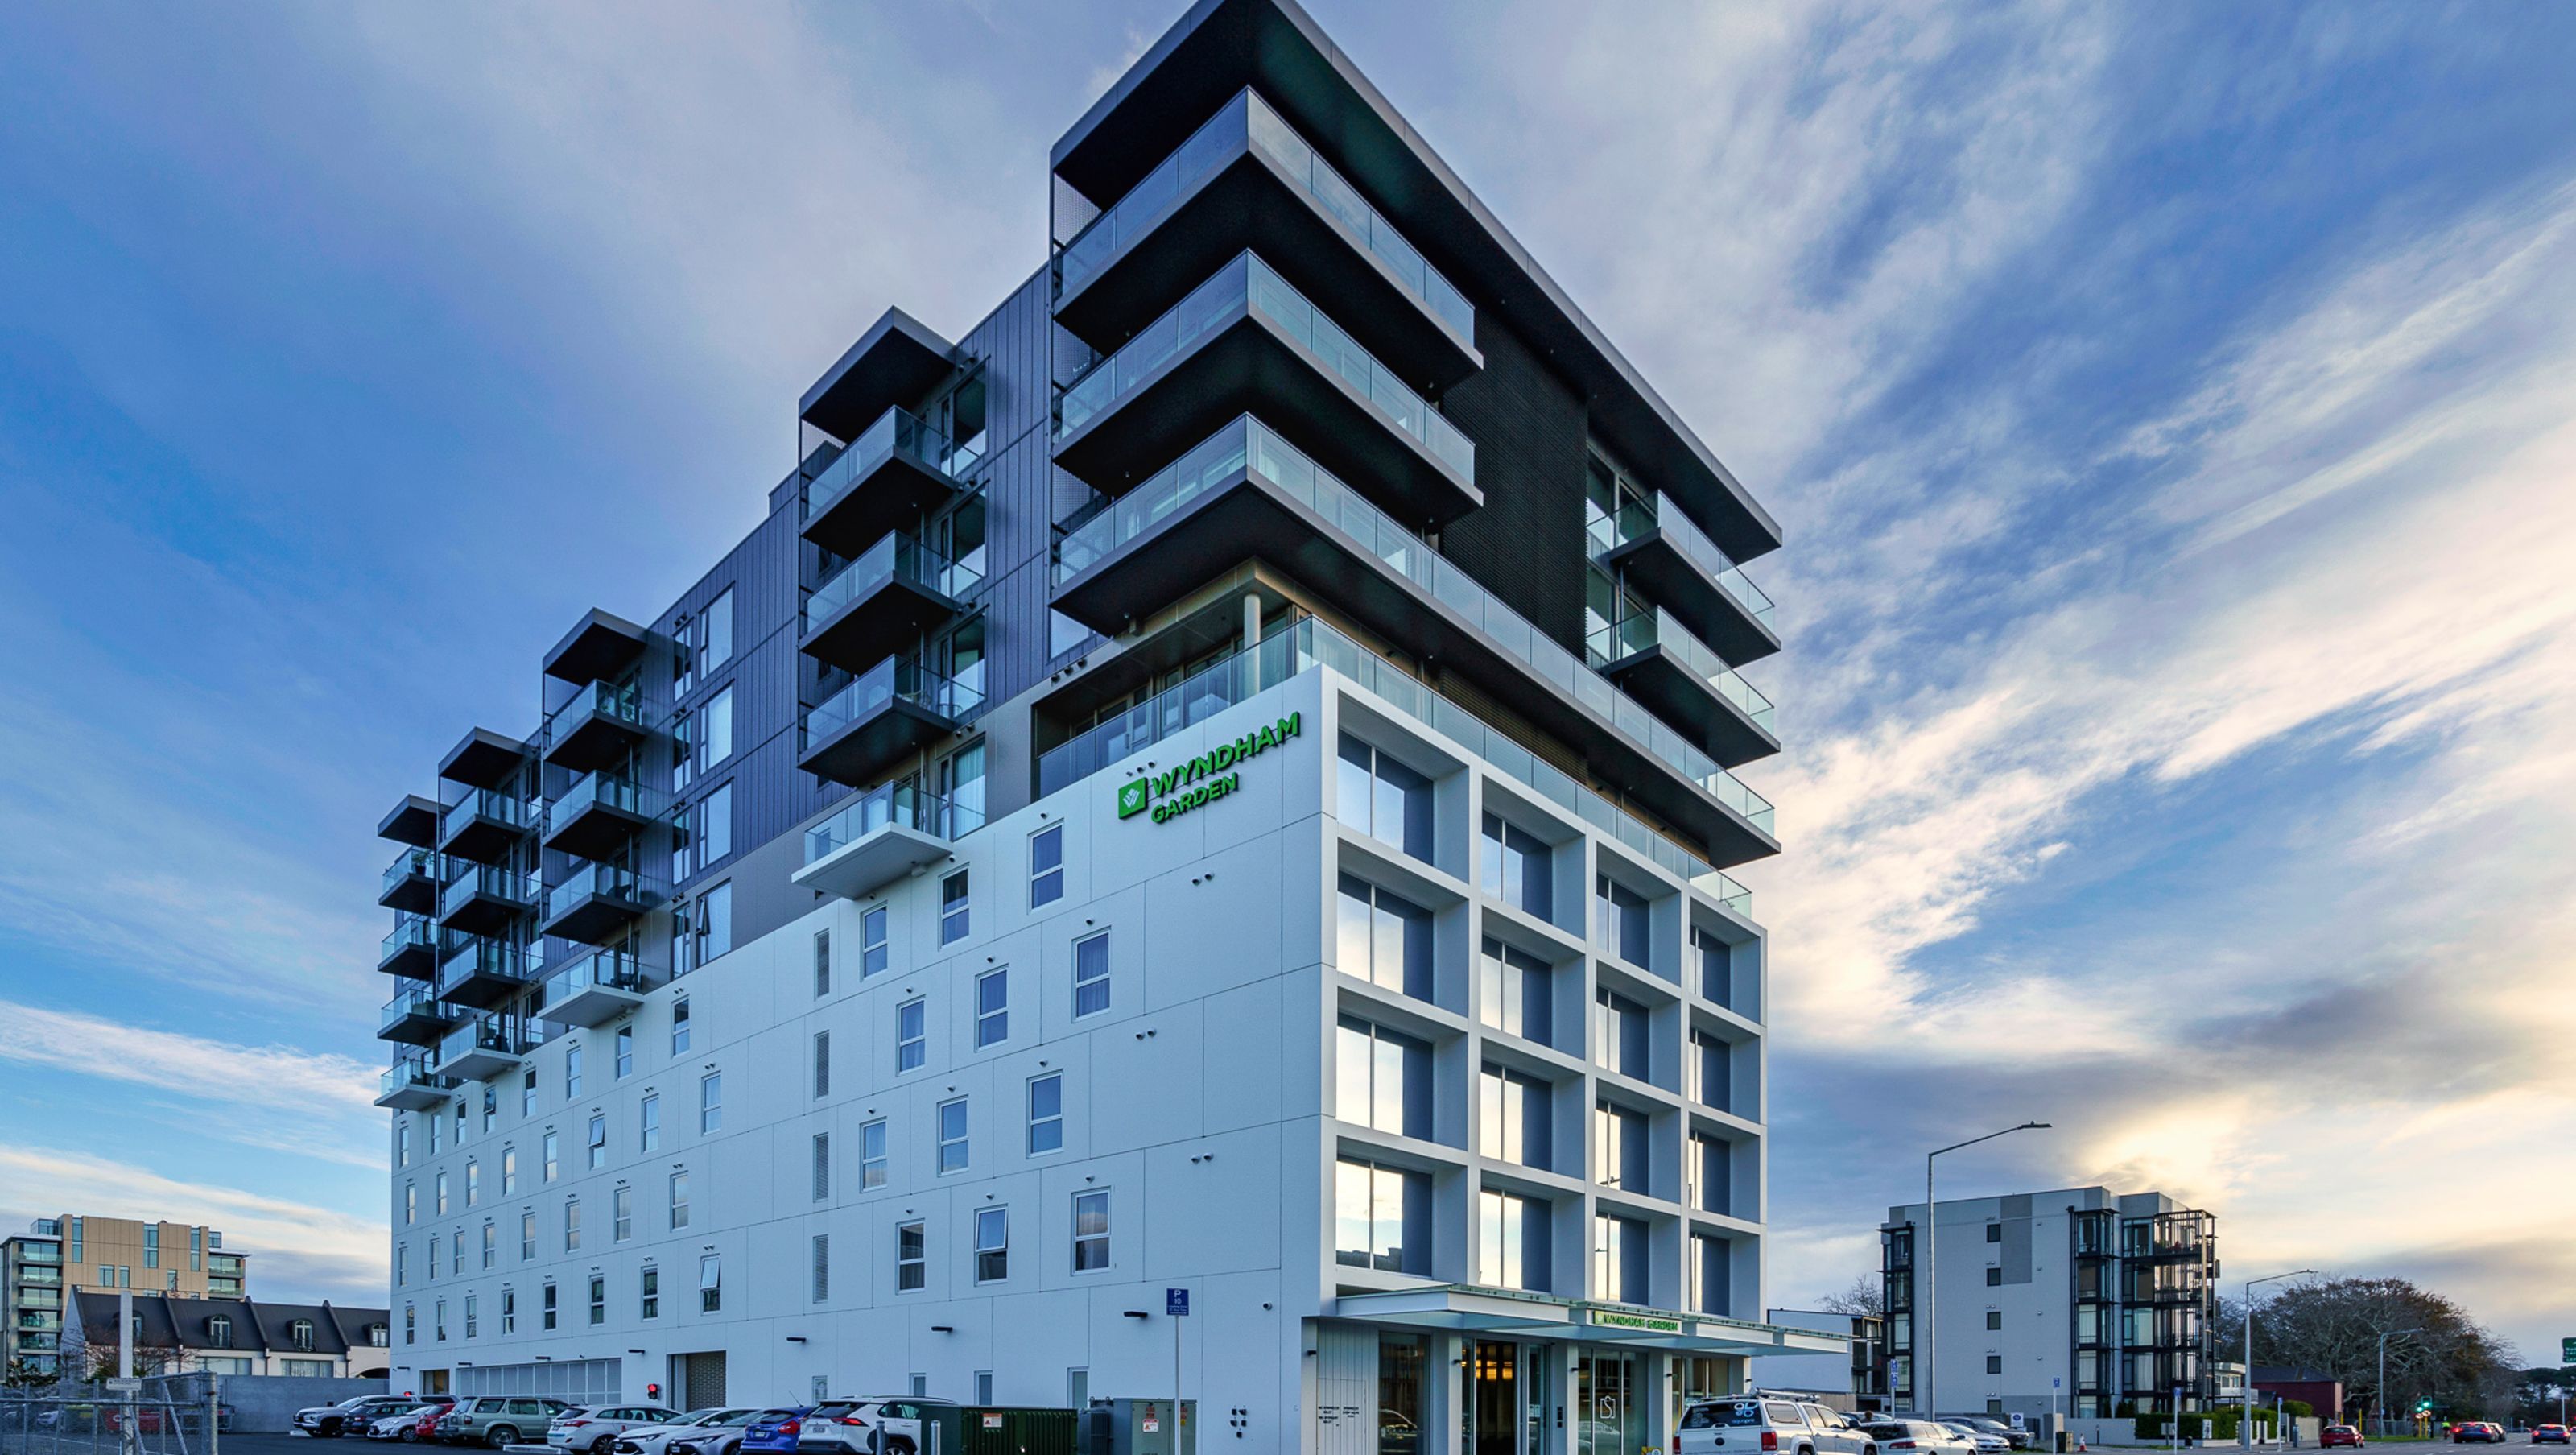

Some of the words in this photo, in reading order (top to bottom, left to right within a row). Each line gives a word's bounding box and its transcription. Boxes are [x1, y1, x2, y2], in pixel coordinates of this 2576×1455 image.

[1151, 711, 1301, 798] WYNDHAM
[1150, 771, 1240, 825] GARDEN
[1174, 1289, 1182, 1297] P
[1604, 1313, 1645, 1328] WYNDHAM
[1647, 1319, 1678, 1331] GARDEN
